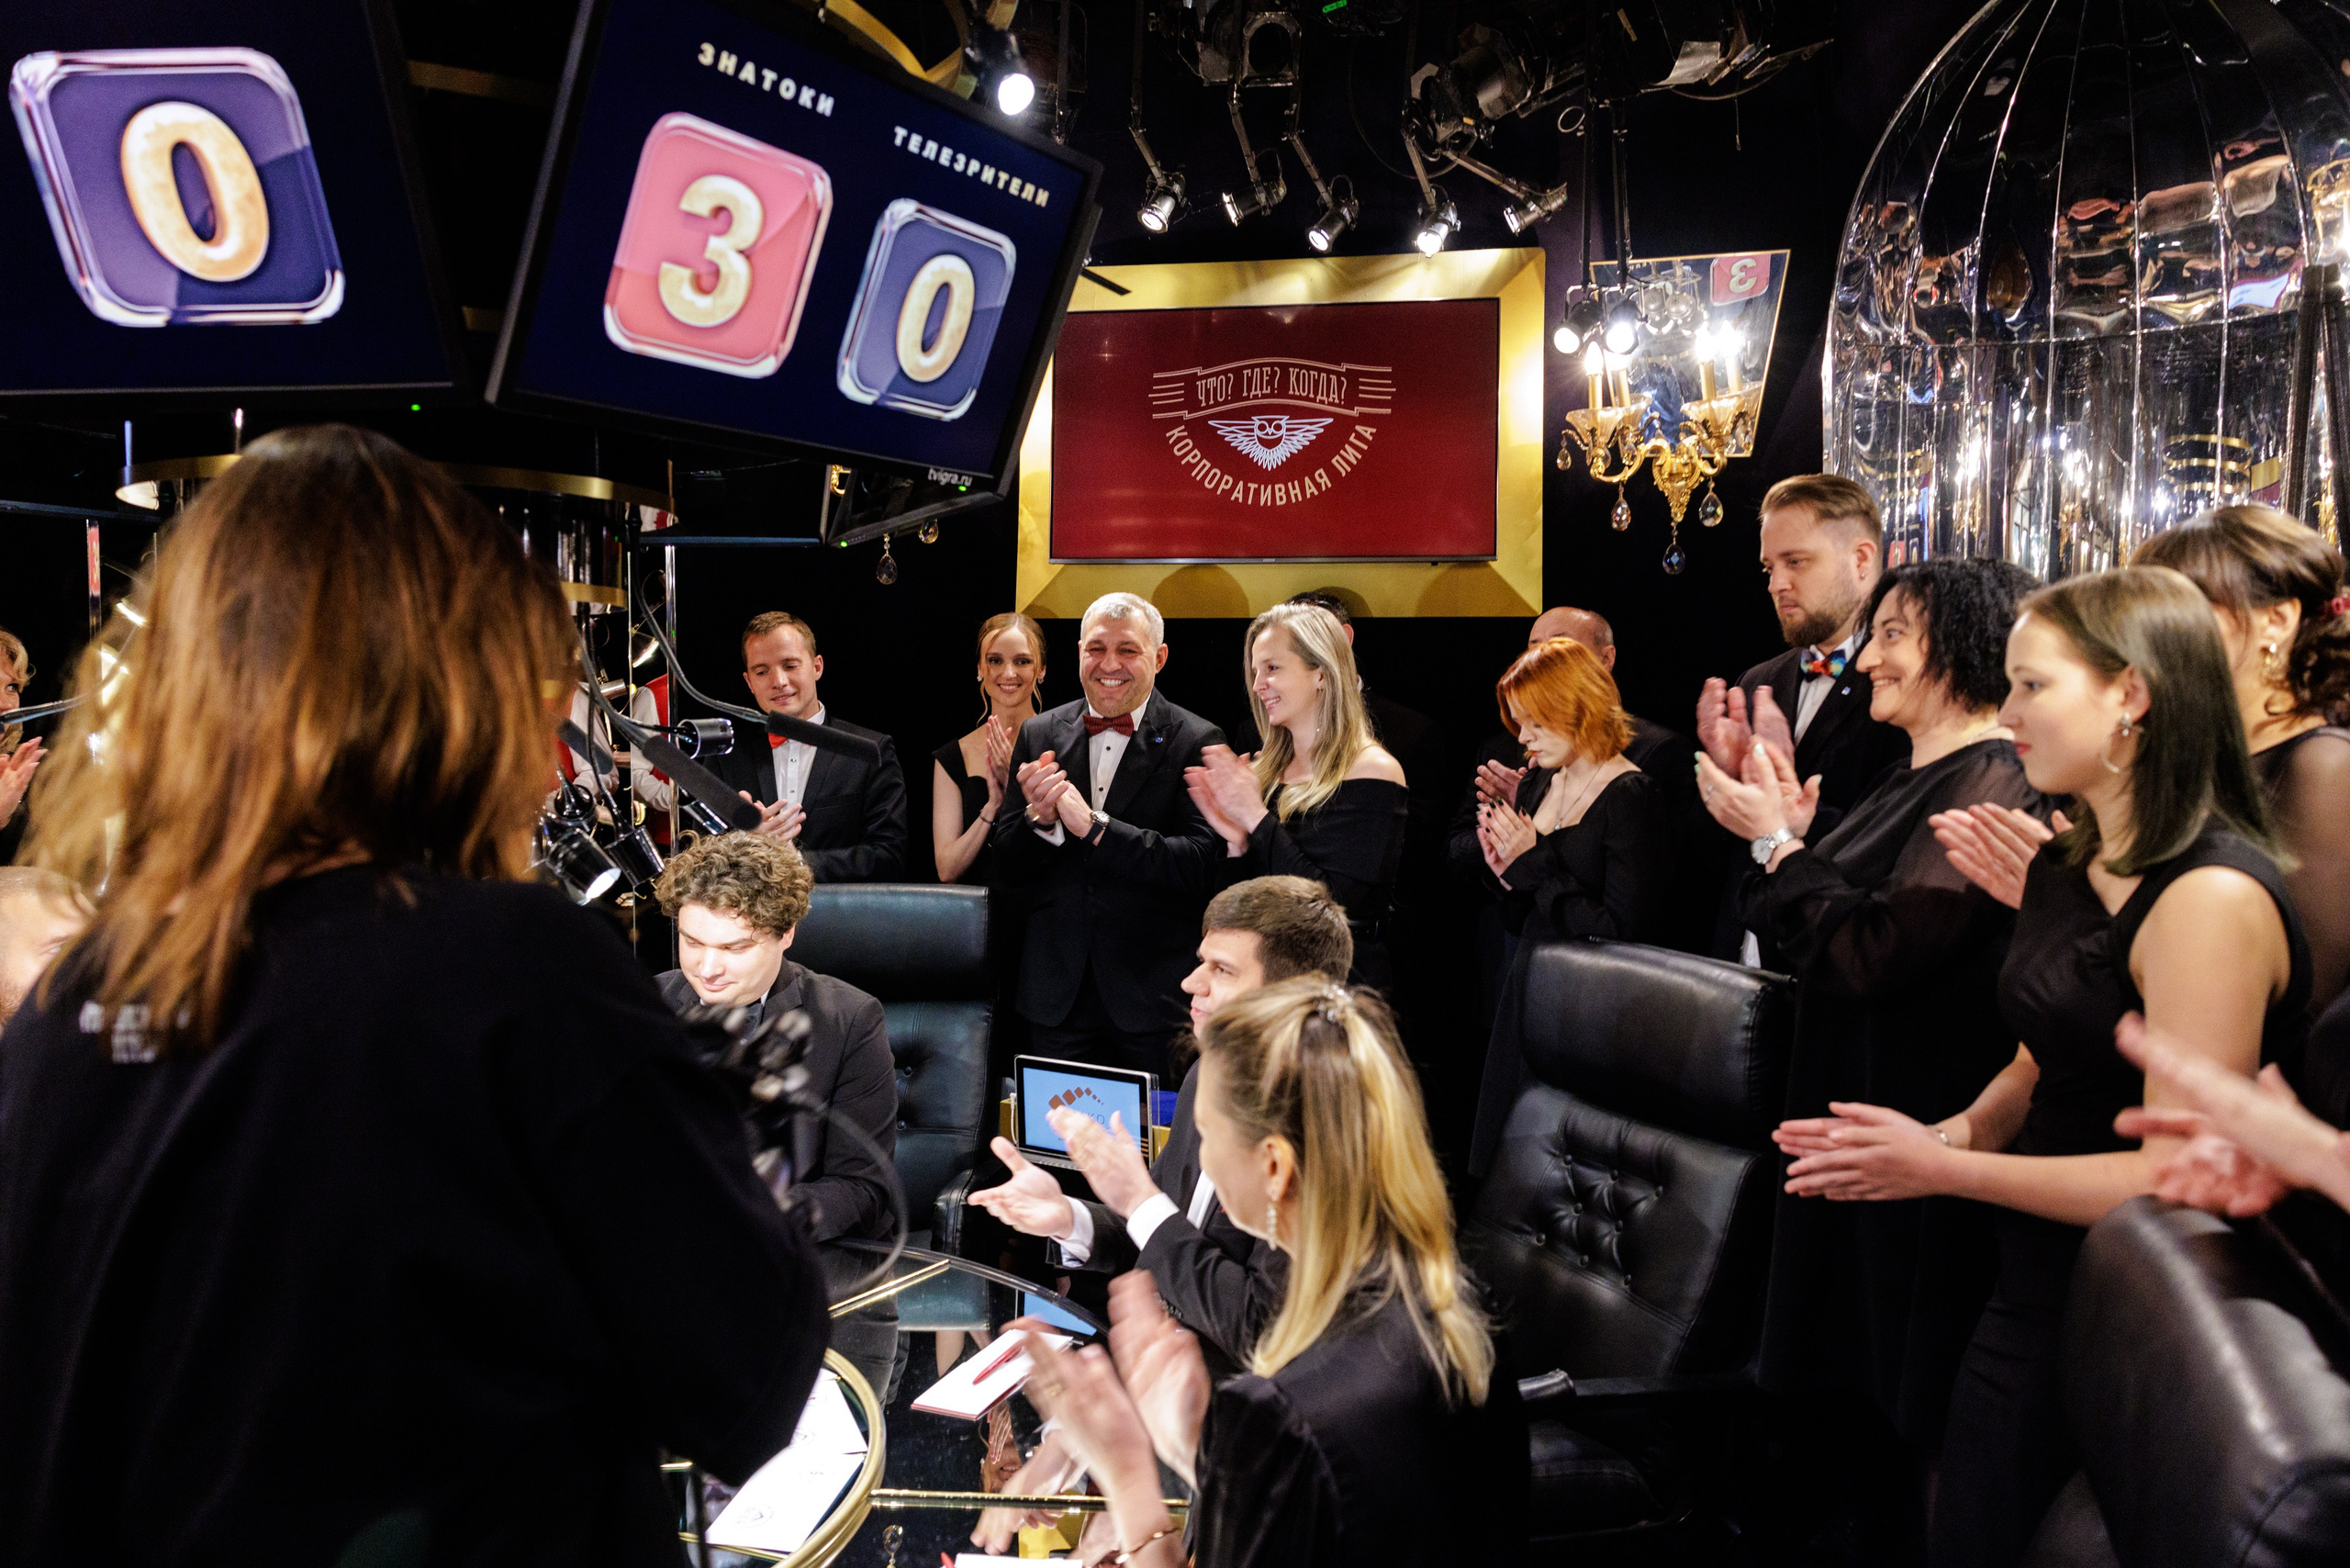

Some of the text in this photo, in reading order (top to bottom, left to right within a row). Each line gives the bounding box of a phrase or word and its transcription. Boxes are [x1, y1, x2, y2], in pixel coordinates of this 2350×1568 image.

[698, 42, 834, 117] ЗНАТОКИ
[121, 102, 269, 282] 0
[894, 125, 1049, 207] ТЕЛЕЗРИТЕЛИ
[658, 174, 763, 328] 3
[896, 254, 975, 382] 0
[1196, 367, 1347, 407] ЧТО? ГДЕ? КОГДА?
[927, 467, 973, 487] tvigra.ru
[1166, 424, 1377, 507] КОРПОРАТИВНАЯ ЛИГА
